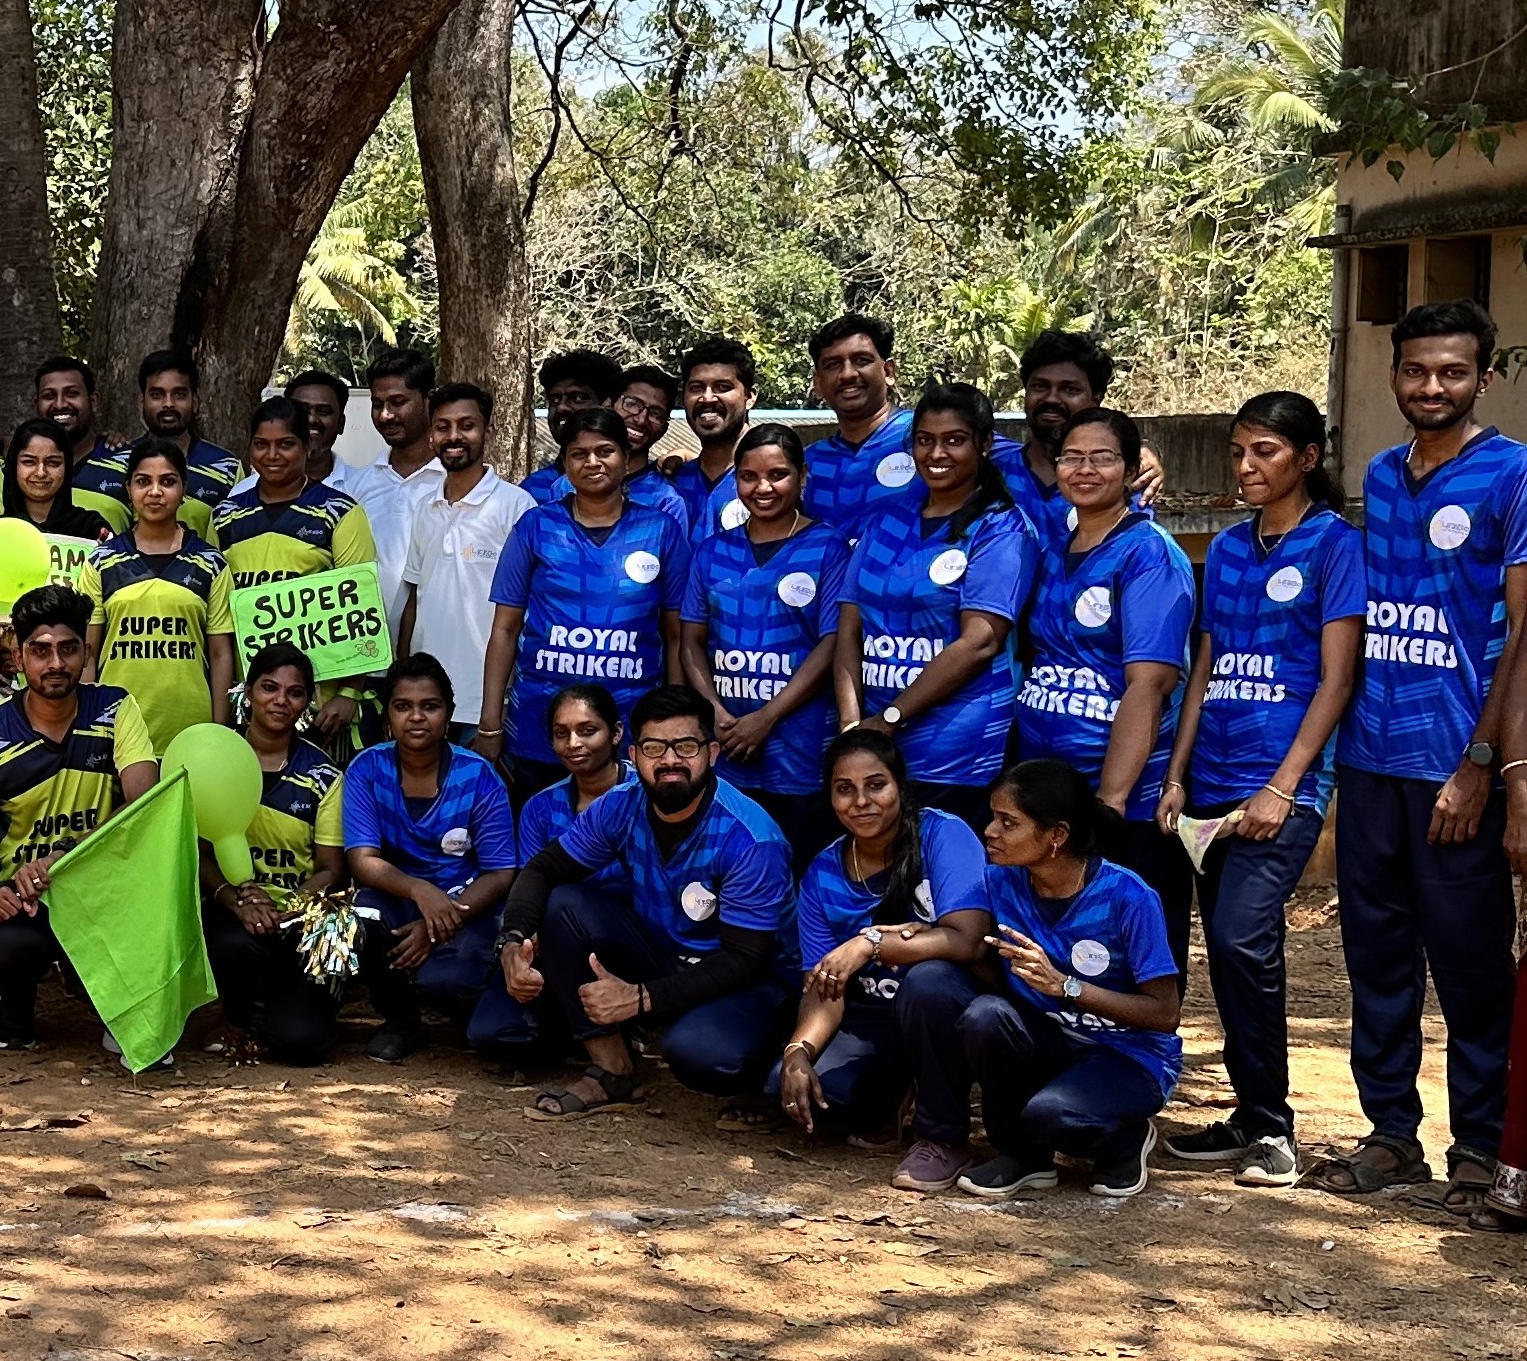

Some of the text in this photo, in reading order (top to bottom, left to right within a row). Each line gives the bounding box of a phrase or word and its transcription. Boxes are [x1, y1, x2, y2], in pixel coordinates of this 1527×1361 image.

[50, 544, 86, 572] AM
[253, 579, 359, 630] SUPER
[119, 616, 188, 636] SUPER
[549, 624, 638, 652] ROYAL
[109, 640, 197, 660] STRIKERS
[535, 648, 643, 679] STRIKERS
[714, 649, 792, 676] ROYAL
[1364, 632, 1458, 668] RIKERS
[713, 674, 788, 701] TRIKER
[861, 660, 924, 689] TRIKE
[29, 808, 98, 840] SUPER
[249, 846, 296, 868] PER
